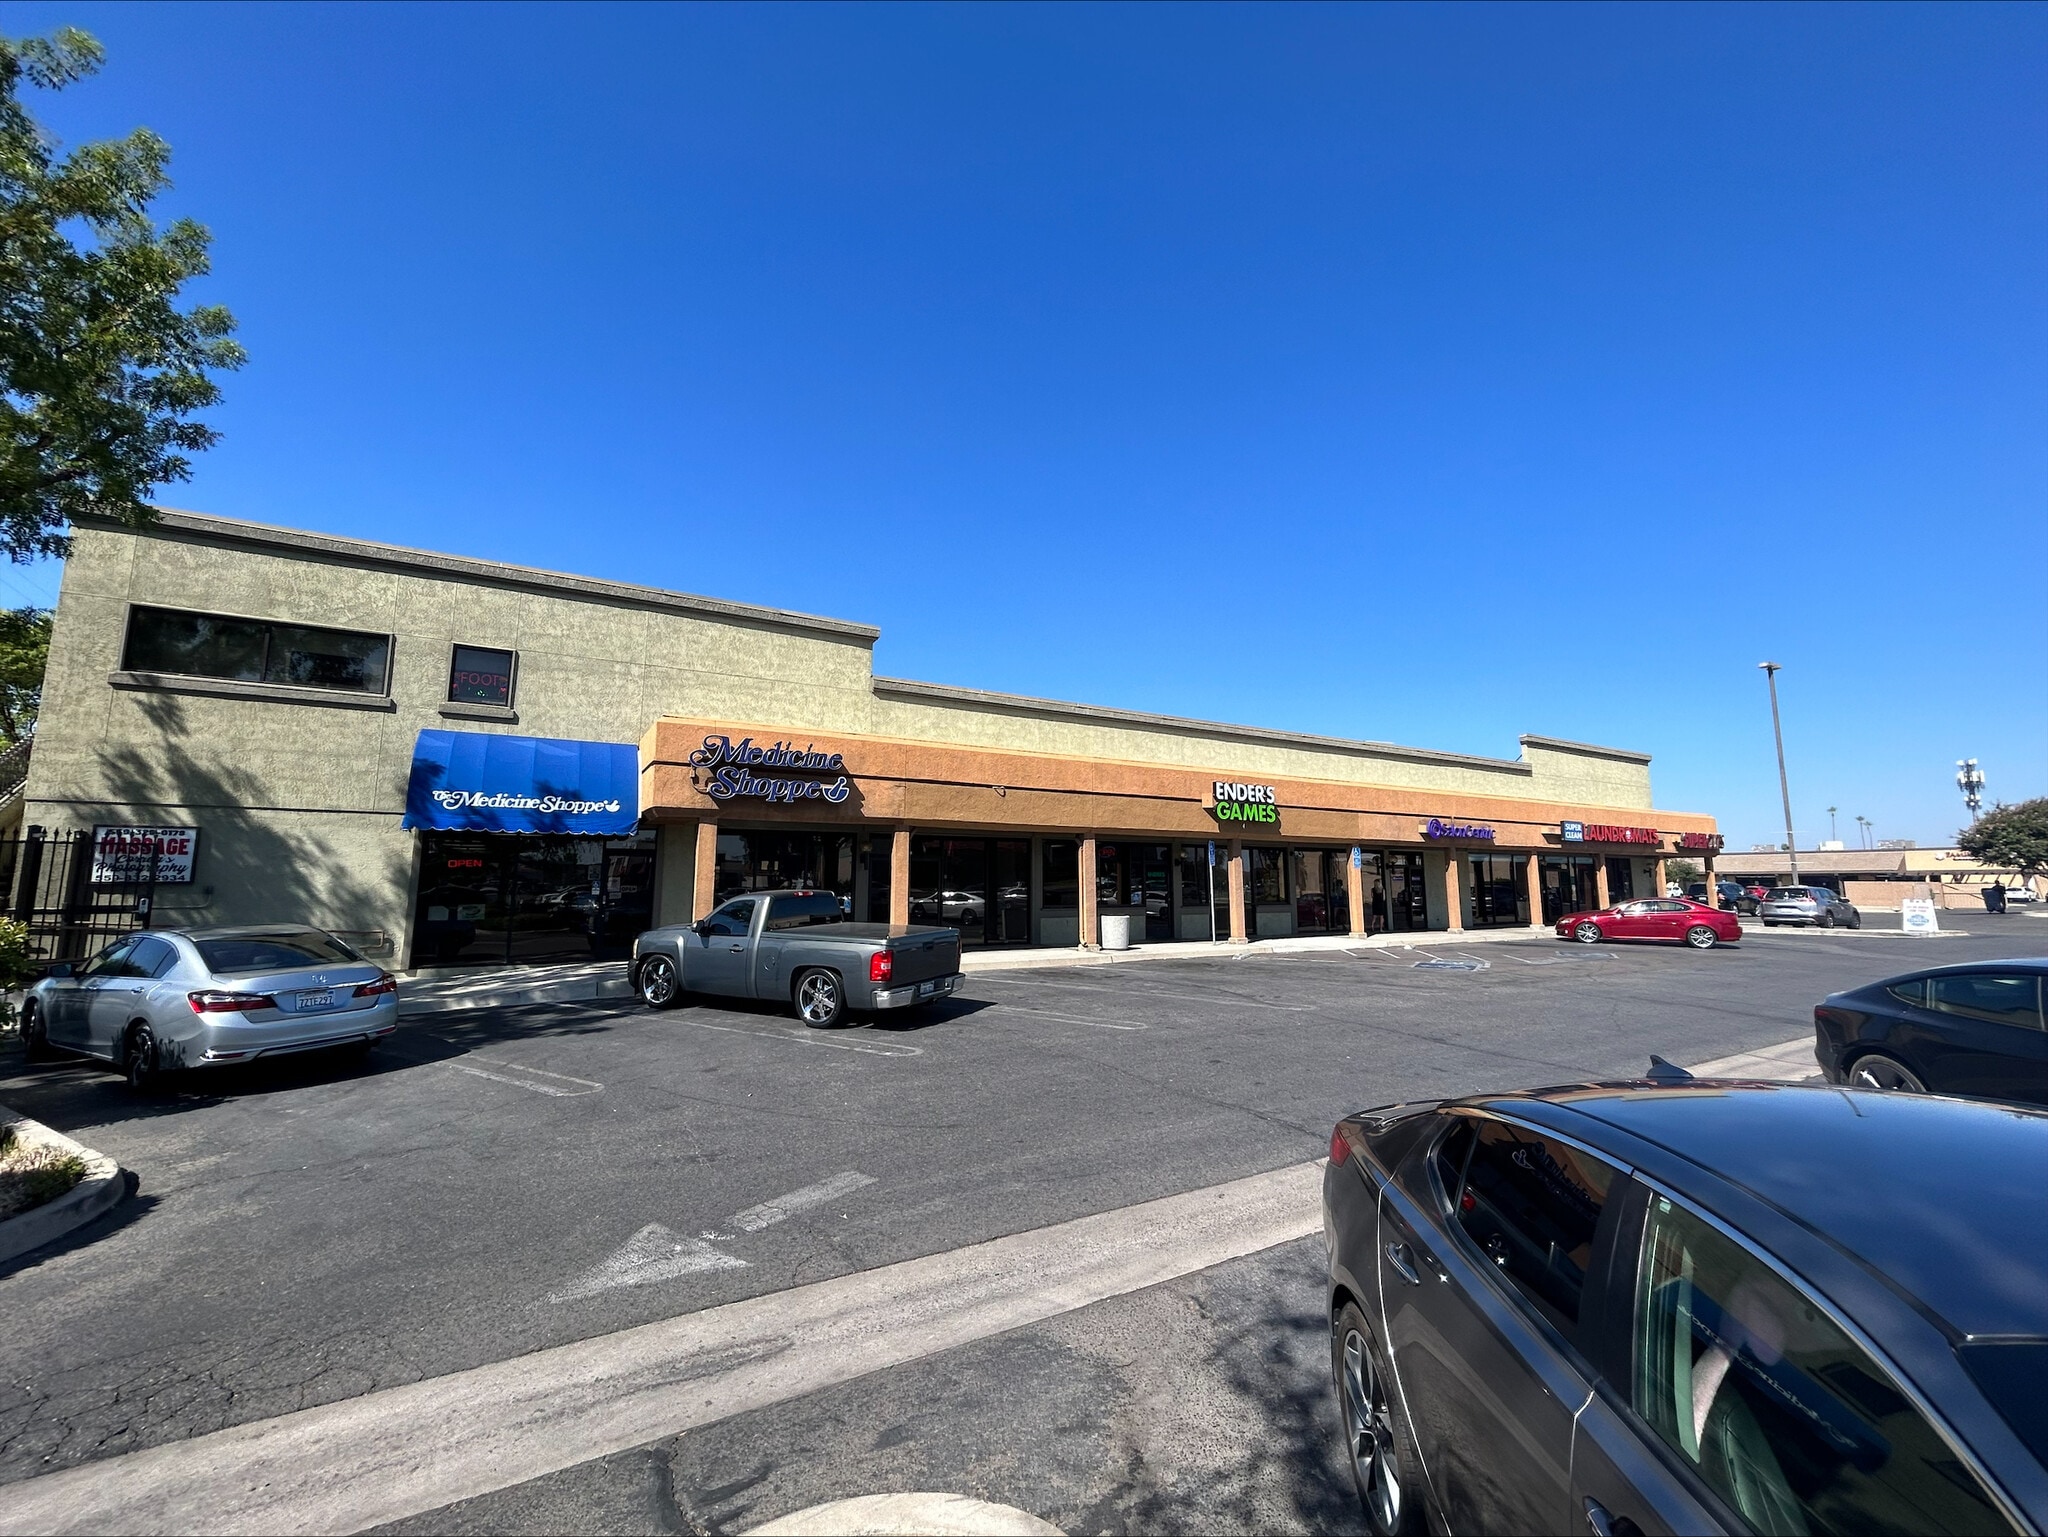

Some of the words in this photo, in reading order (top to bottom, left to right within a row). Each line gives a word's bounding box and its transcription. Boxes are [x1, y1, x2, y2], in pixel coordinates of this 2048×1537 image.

[460, 672, 500, 686] FOOT
[689, 734, 843, 770] Medicine
[709, 766, 822, 803] Shoppe
[1214, 781, 1276, 804] ENDER'S
[443, 791, 540, 810] Medicine
[539, 795, 604, 814] Shoppe
[1216, 801, 1277, 823] GAMES
[1564, 823, 1582, 831] SUPER
[1564, 831, 1583, 840] CLEAN
[1583, 824, 1660, 844] LAUNDROMATS
[99, 837, 191, 855] MASSAGE
[447, 859, 482, 868] OPEN
